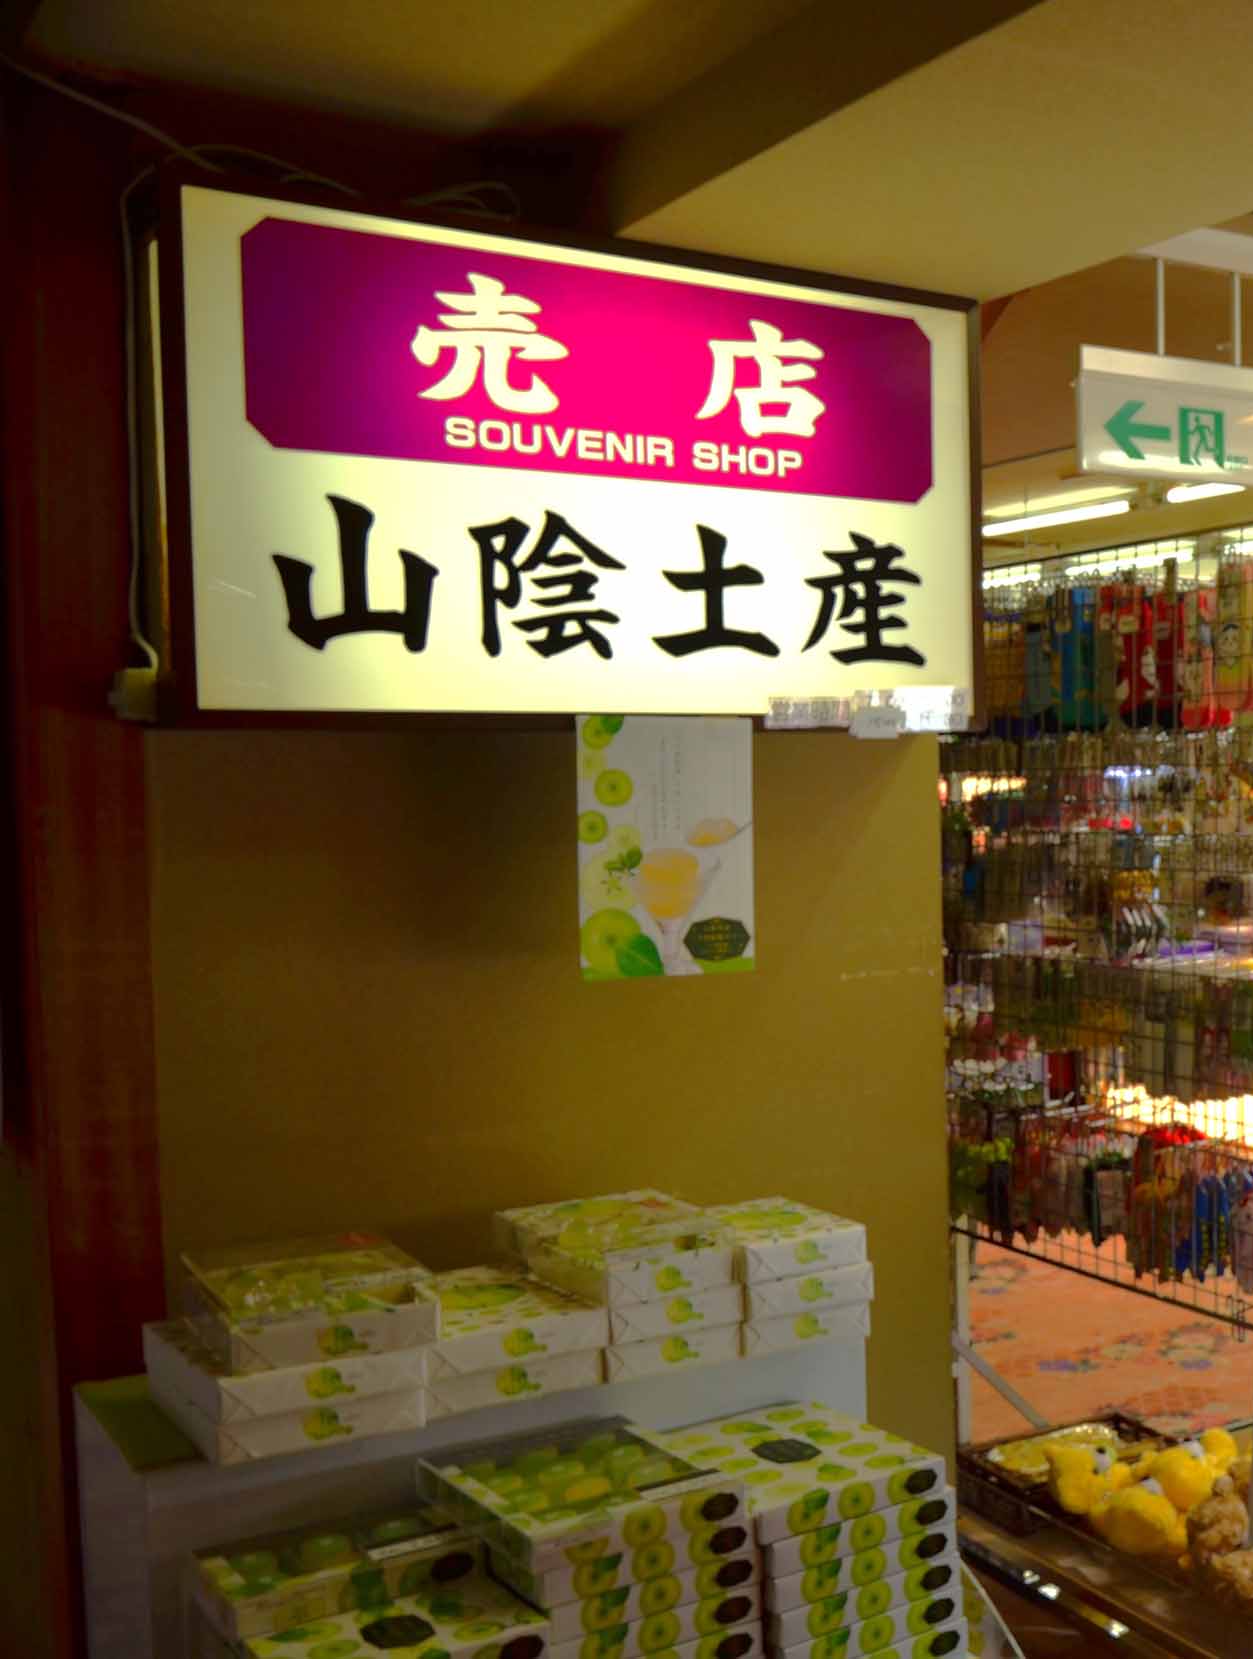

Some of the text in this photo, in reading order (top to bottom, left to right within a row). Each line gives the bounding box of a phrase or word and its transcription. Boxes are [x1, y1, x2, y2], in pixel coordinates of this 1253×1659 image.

[411, 271, 827, 439] 売店
[444, 415, 803, 478] SOUVENIR SHOP
[271, 493, 927, 667] 山陰土産
